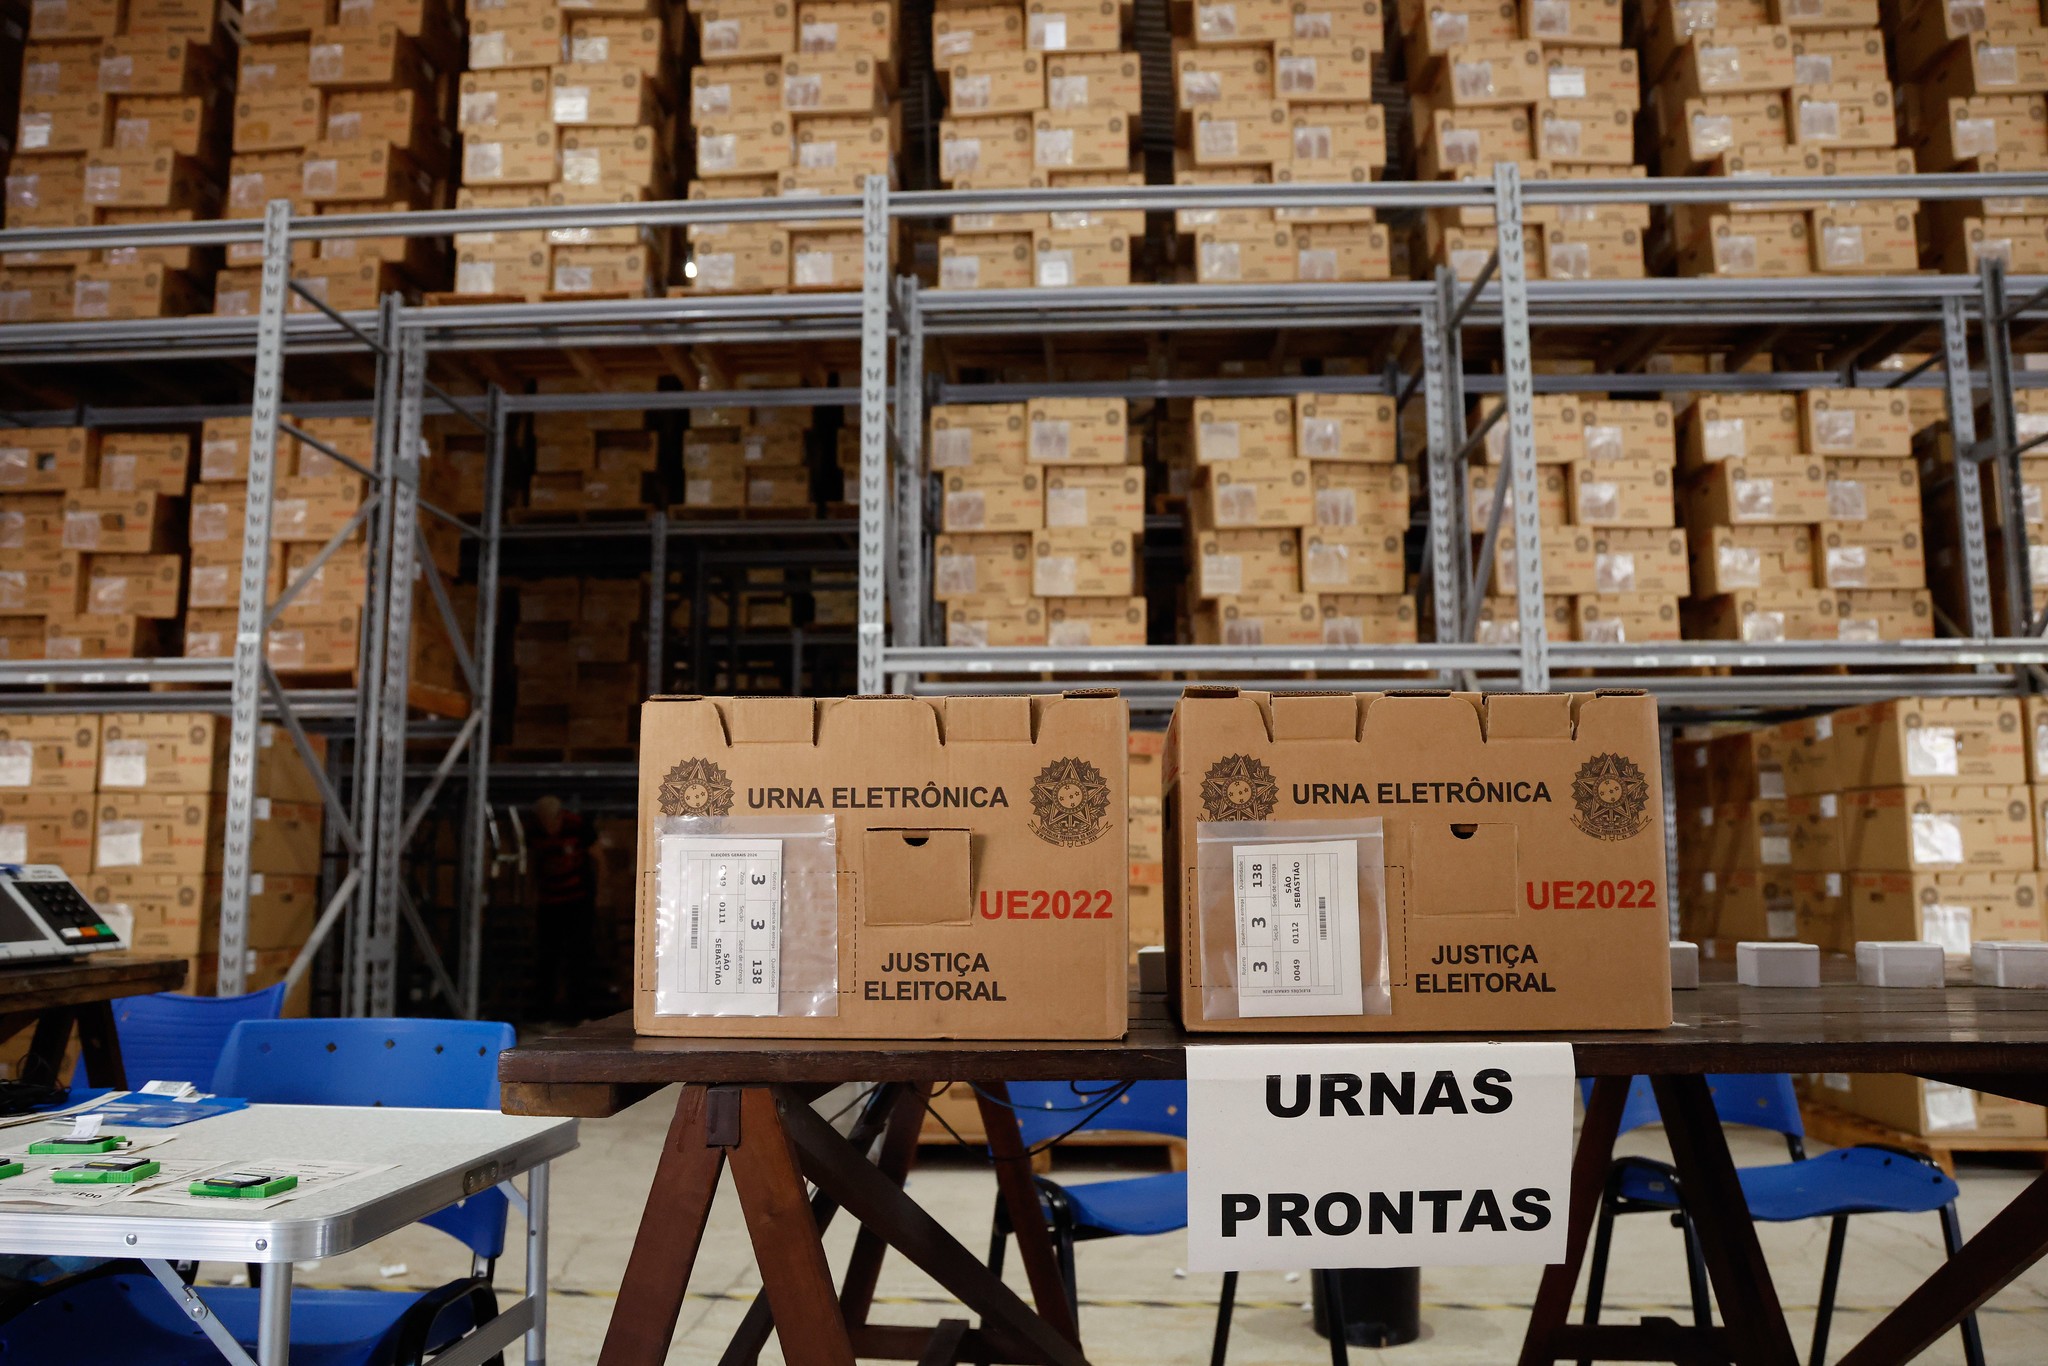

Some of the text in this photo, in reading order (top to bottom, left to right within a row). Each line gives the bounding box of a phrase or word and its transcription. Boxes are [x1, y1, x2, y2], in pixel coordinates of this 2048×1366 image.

[748, 781, 1009, 809] URNA ELETRÔNICA
[1292, 776, 1552, 805] URNA ELETRÔNICA
[719, 865, 727, 887] 049
[751, 874, 766, 886] 3
[1252, 863, 1263, 888] 138
[1284, 876, 1292, 894] SÃO
[1293, 861, 1301, 908] SEBASTIÃO
[980, 889, 1113, 920] UE2022
[1526, 880, 1656, 911] UE2022
[718, 901, 726, 924] 0111
[751, 919, 765, 930] 3
[1252, 917, 1267, 928] 3
[714, 938, 722, 986] SEBASTIÃO
[723, 953, 731, 971] SÃO
[881, 952, 990, 978] JUSTIÇA
[1253, 961, 1268, 973] 3
[1431, 944, 1539, 970] JUSTIÇA
[752, 960, 762, 985] 138
[1293, 959, 1301, 982] 0049
[1415, 972, 1556, 994] ELEITORAL
[864, 981, 1006, 1002] ELEITORAL
[1265, 1068, 1513, 1119] URNAS
[1221, 1187, 1552, 1238] PRONTAS
